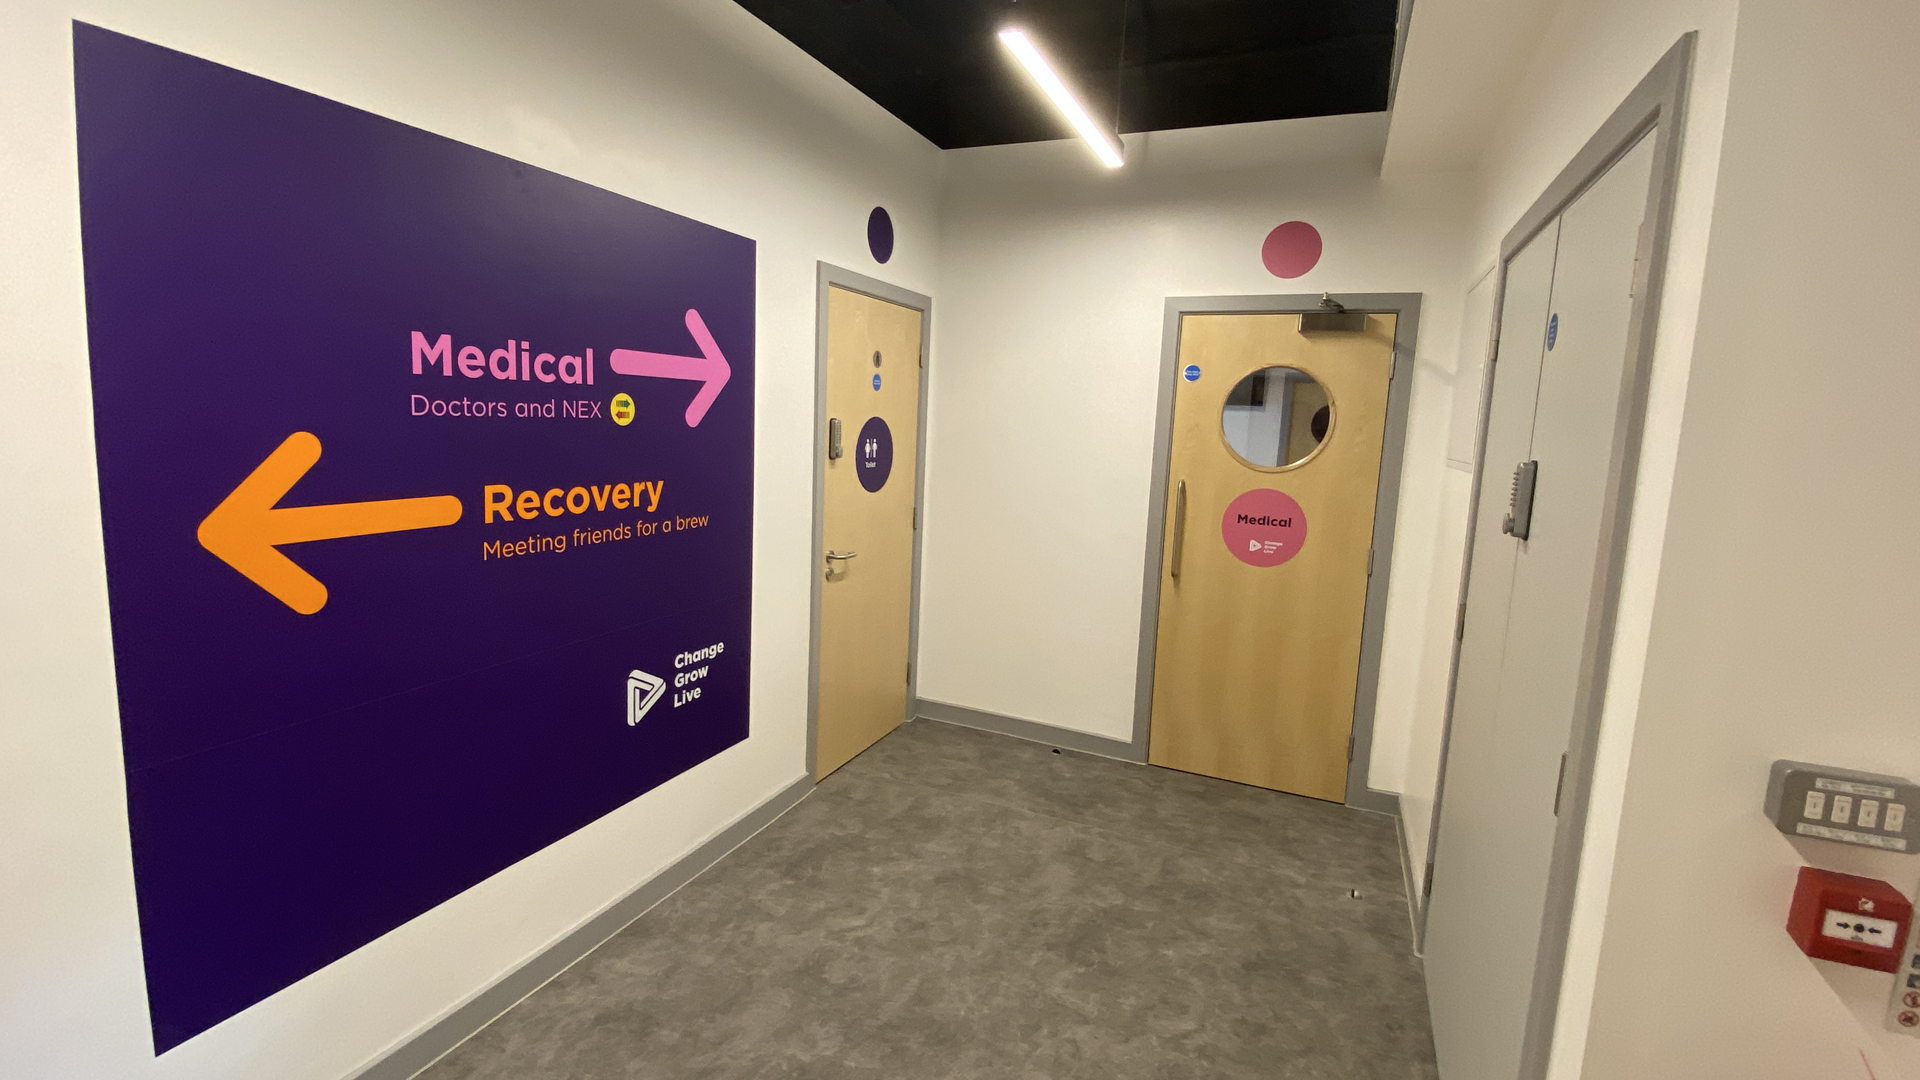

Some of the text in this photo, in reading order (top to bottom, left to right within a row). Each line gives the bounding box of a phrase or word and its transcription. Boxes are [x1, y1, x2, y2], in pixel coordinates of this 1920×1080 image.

[411, 330, 594, 385] Medical
[411, 394, 602, 419] Doctors and NEX
[484, 480, 664, 524] Recovery
[1237, 514, 1291, 527] Medical
[483, 515, 709, 561] Meeting friends for a brew
[674, 642, 724, 668] Change
[674, 665, 708, 687] Grow
[674, 687, 701, 707] Live
